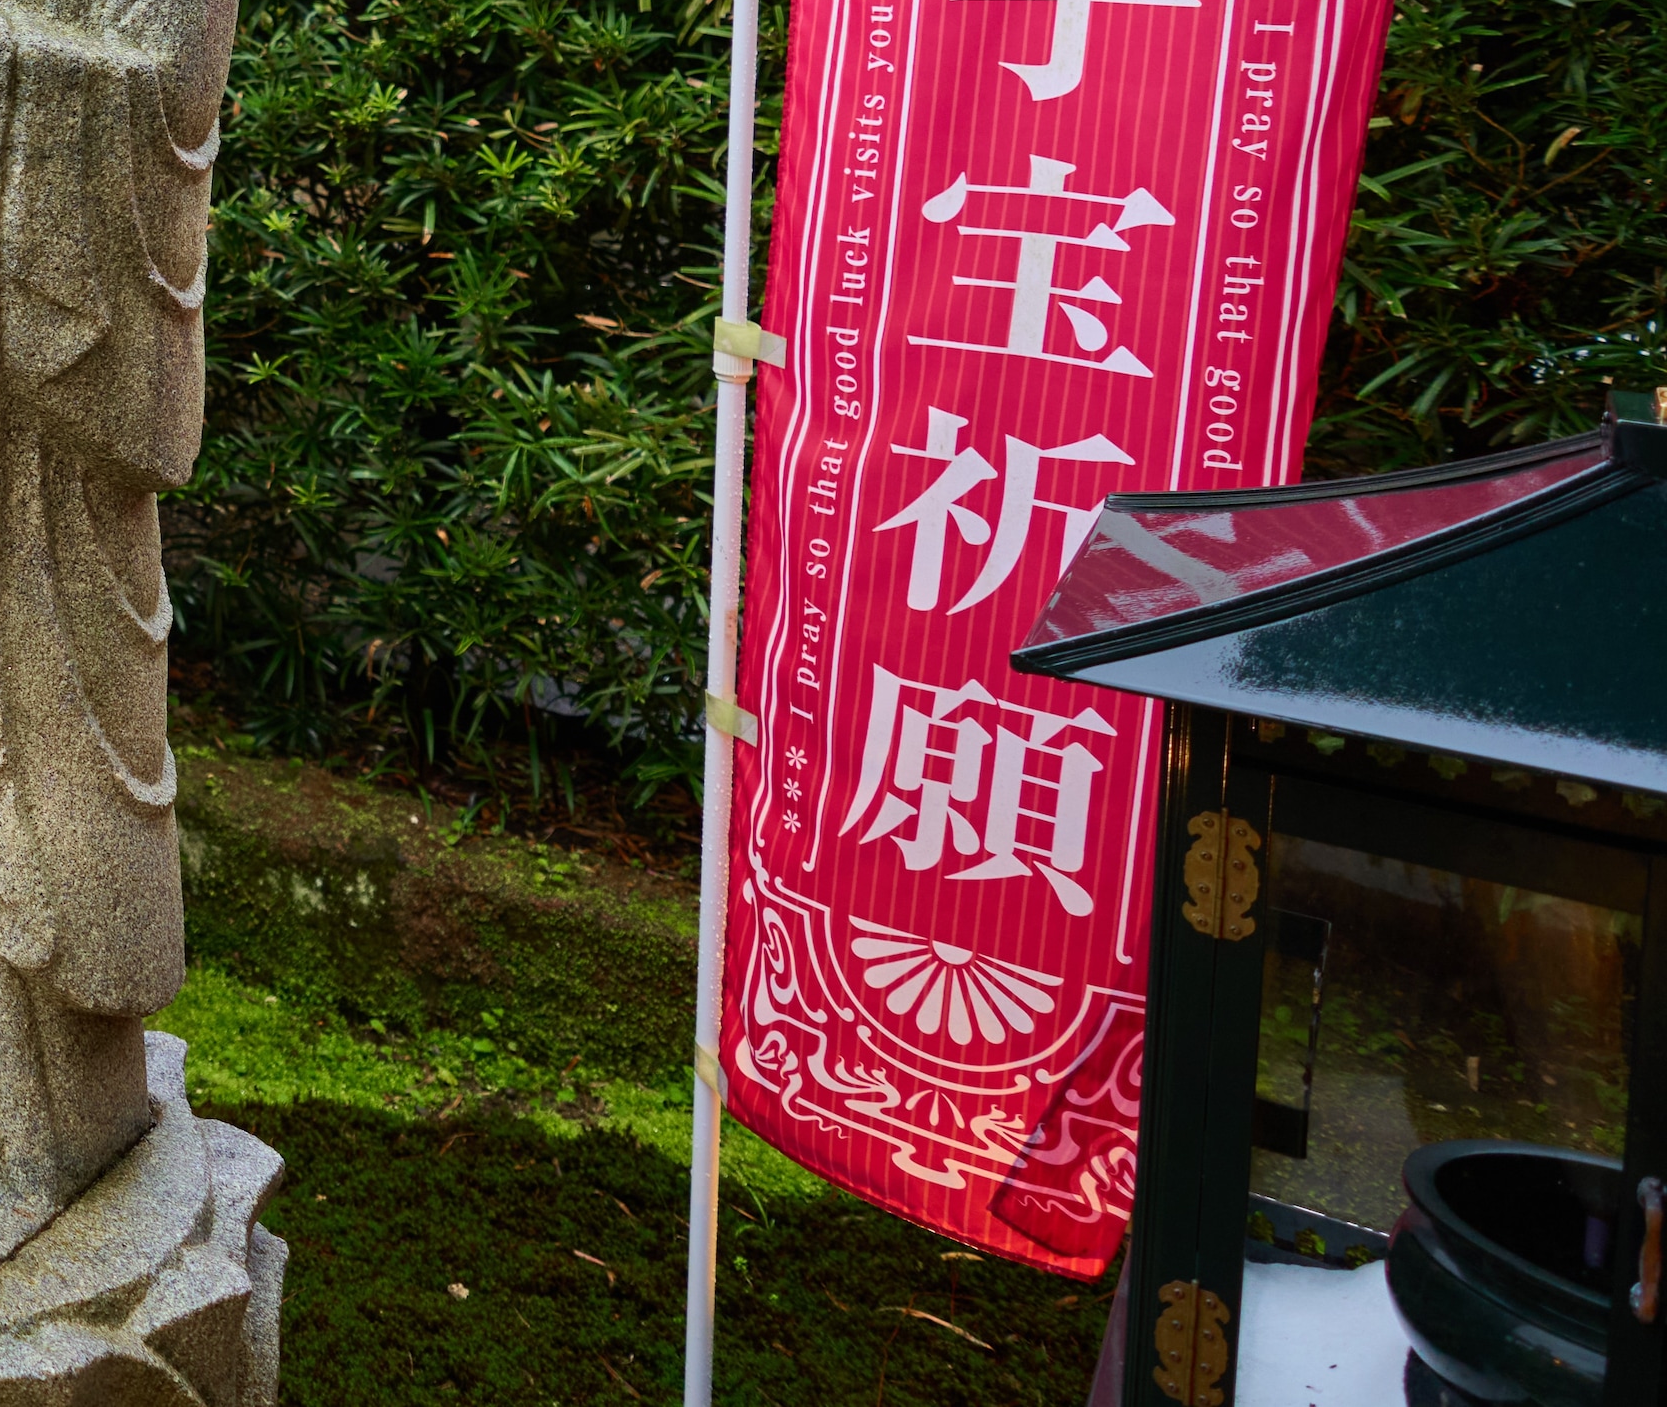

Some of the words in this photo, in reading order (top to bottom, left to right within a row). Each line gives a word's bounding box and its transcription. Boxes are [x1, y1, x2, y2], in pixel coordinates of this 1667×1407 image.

[866, 5, 895, 73] you
[1252, 20, 1295, 37] I
[844, 94, 886, 203] visits
[1230, 60, 1277, 161] pray
[1229, 185, 1262, 229] so
[828, 226, 871, 306] luck
[1215, 255, 1265, 344] that
[825, 325, 862, 420] good
[1202, 365, 1243, 470] good
[806, 438, 849, 516] that
[805, 538, 831, 579] so
[795, 597, 827, 691] pray
[788, 704, 814, 722] I
